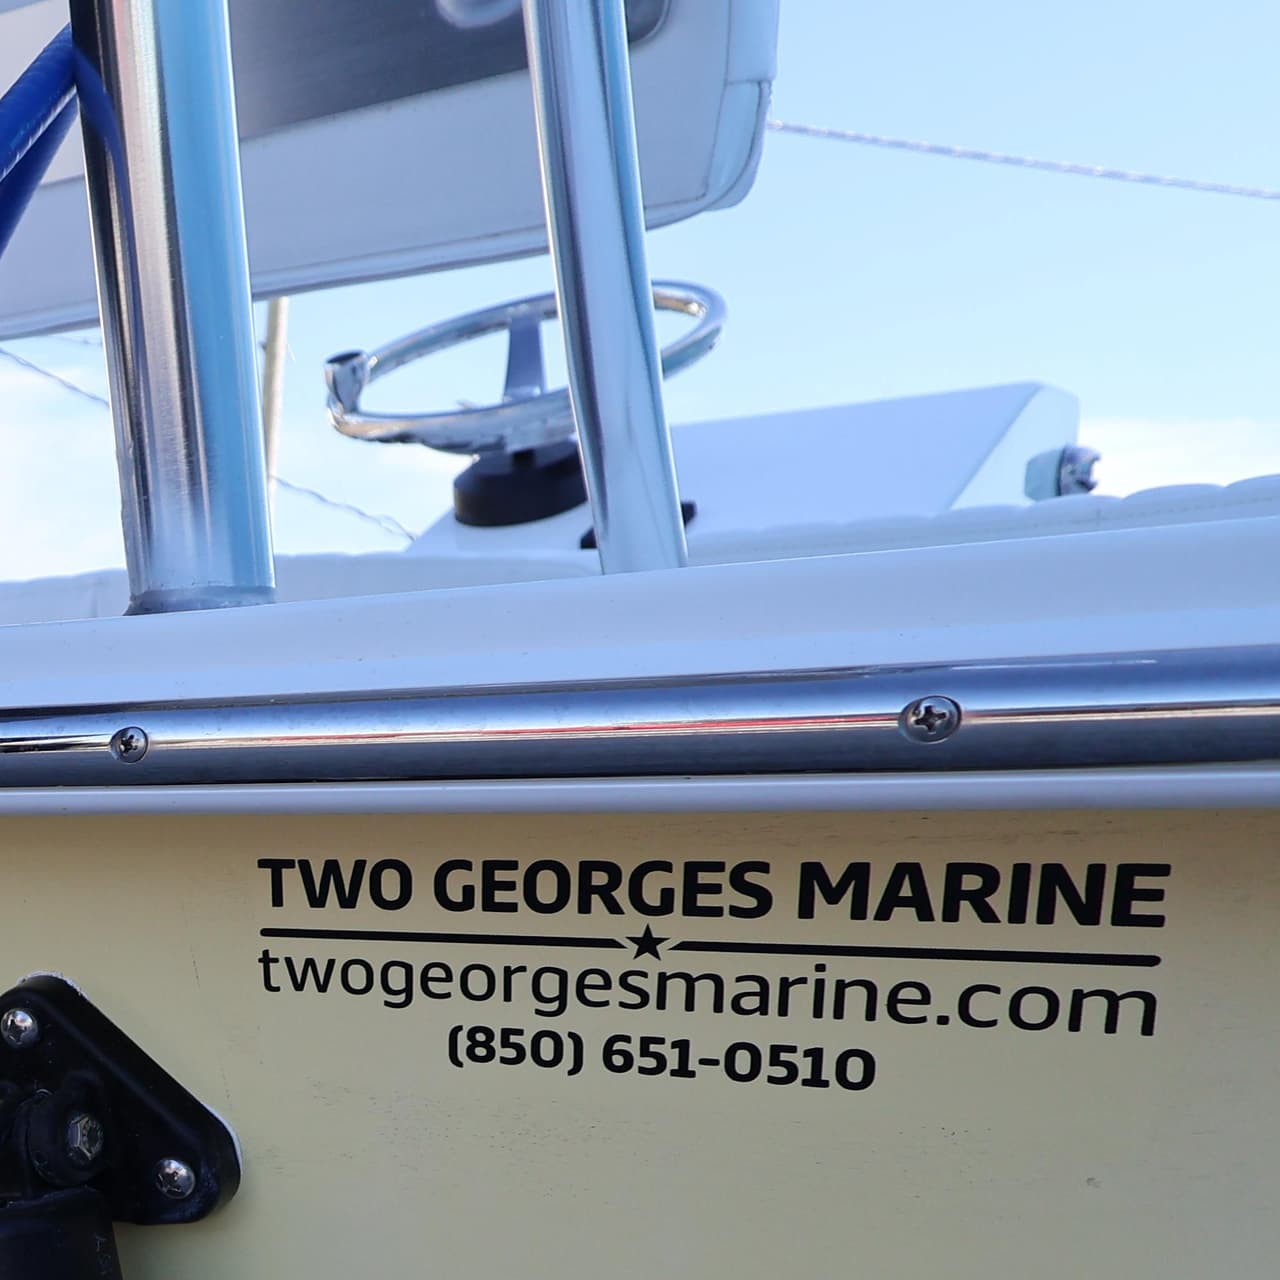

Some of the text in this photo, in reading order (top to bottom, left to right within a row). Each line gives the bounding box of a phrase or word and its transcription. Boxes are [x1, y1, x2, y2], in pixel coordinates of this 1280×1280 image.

[256, 858, 1172, 928] TWO GEORGES MARINE
[257, 949, 1158, 1037] twogeorgesmarine.com
[448, 1024, 876, 1091] (850) 651-0510
